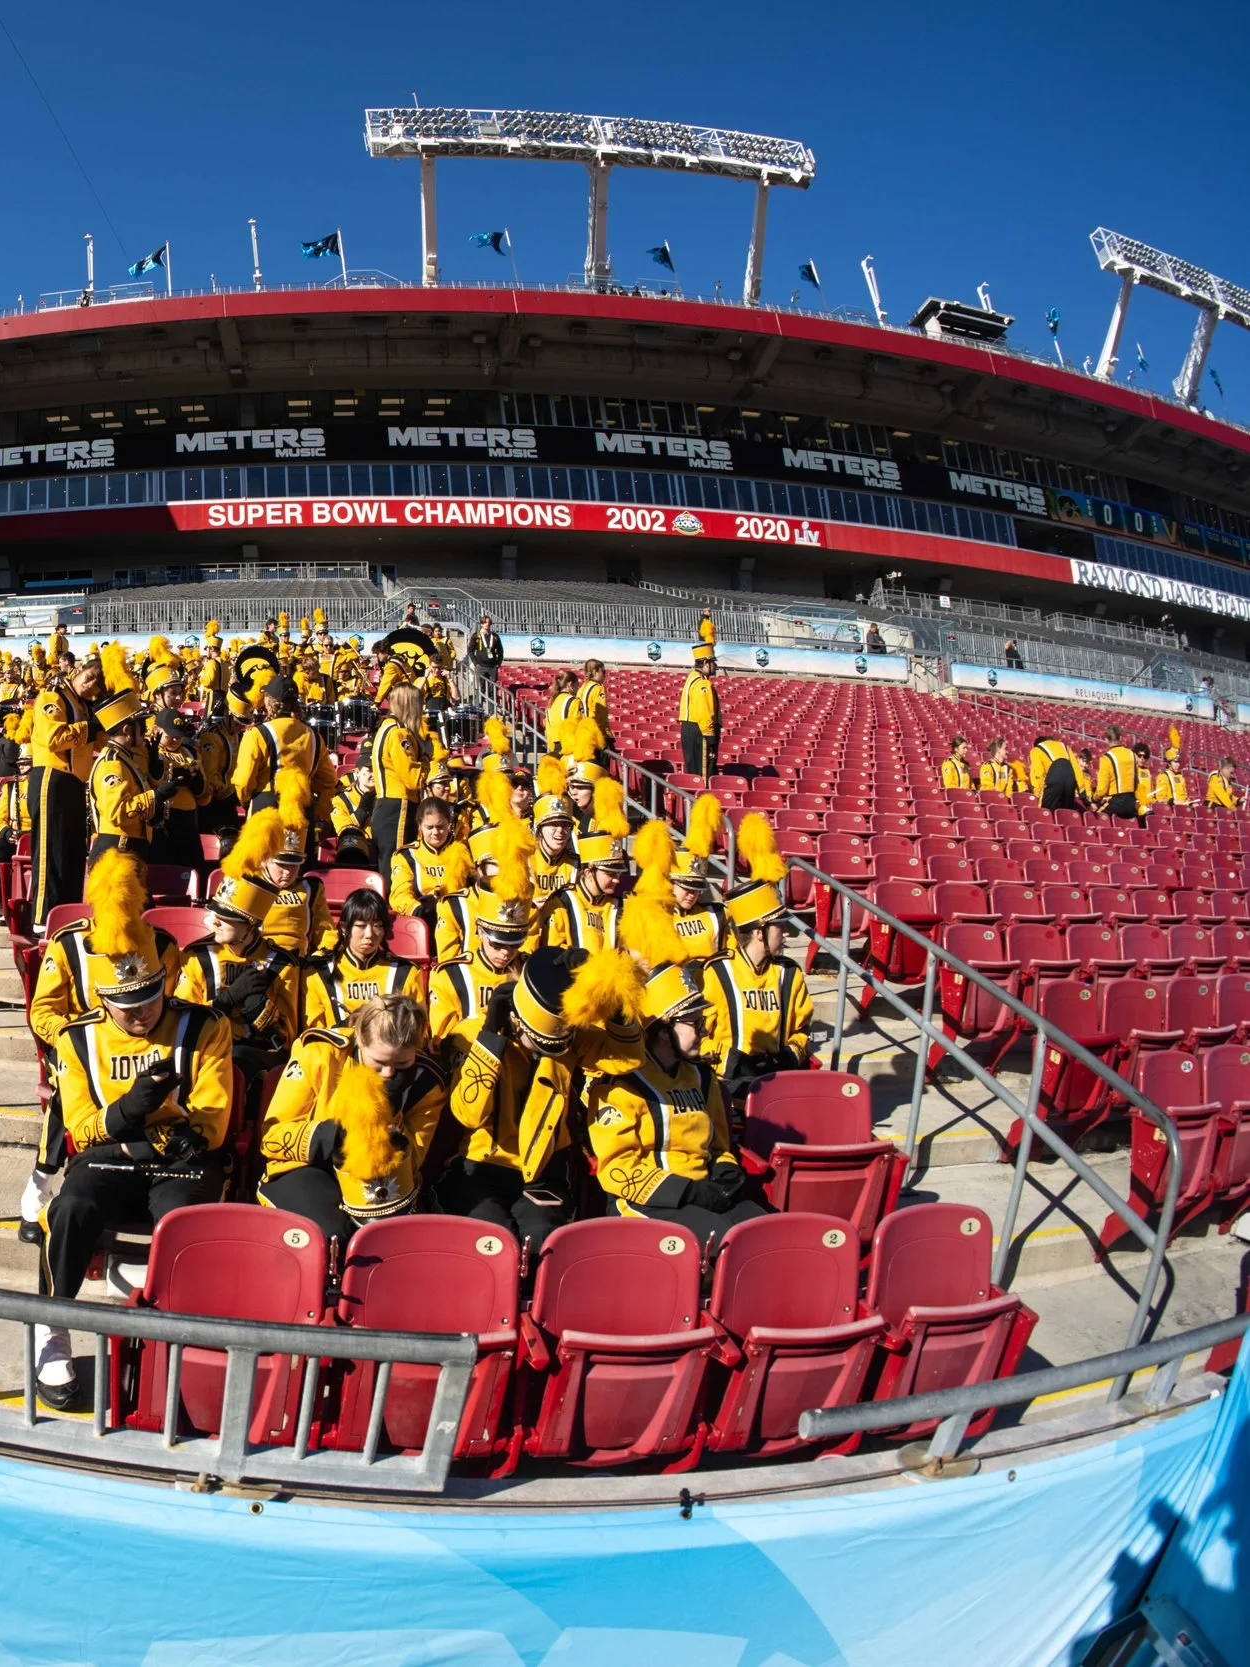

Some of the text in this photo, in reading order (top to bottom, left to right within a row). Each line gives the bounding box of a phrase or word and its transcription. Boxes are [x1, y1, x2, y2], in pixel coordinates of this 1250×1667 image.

[175, 428, 325, 453] METERS
[388, 427, 537, 449] METERS
[596, 432, 731, 460] METERS
[275, 446, 325, 457] MUSIC
[488, 447, 538, 459] MUSIC
[66, 456, 115, 469] MUSIC
[689, 458, 733, 471] MUSIC
[783, 448, 899, 480] METERS
[864, 475, 901, 491] MUSIC
[949, 471, 1047, 505] METERS
[1016, 499, 1047, 515] MUSIC
[208, 501, 303, 527] SUPER
[312, 502, 397, 524] BOWL
[404, 501, 572, 527] CHAMPIONS
[607, 508, 666, 531] 2002
[735, 516, 790, 541] 2020
[1103, 504, 1113, 526] 0
[1134, 512, 1143, 533] 0
[1075, 561, 1163, 602] RAYMOND
[1166, 581, 1213, 612] JAMES
[1075, 688, 1119, 702] RELIAQUEST
[425, 866, 445, 877] IOW
[537, 874, 565, 890] IOWA
[586, 911, 605, 933] IOWA
[676, 919, 707, 936] OWA
[347, 982, 379, 1000] IOWA
[480, 986, 494, 1007] IO
[743, 990, 781, 1012] IOWA
[667, 1088, 707, 1115] IOWA
[291, 1233, 300, 1244] 5
[484, 1240, 493, 1251] 4
[667, 1240, 676, 1251] 3
[829, 1233, 838, 1244] 2
